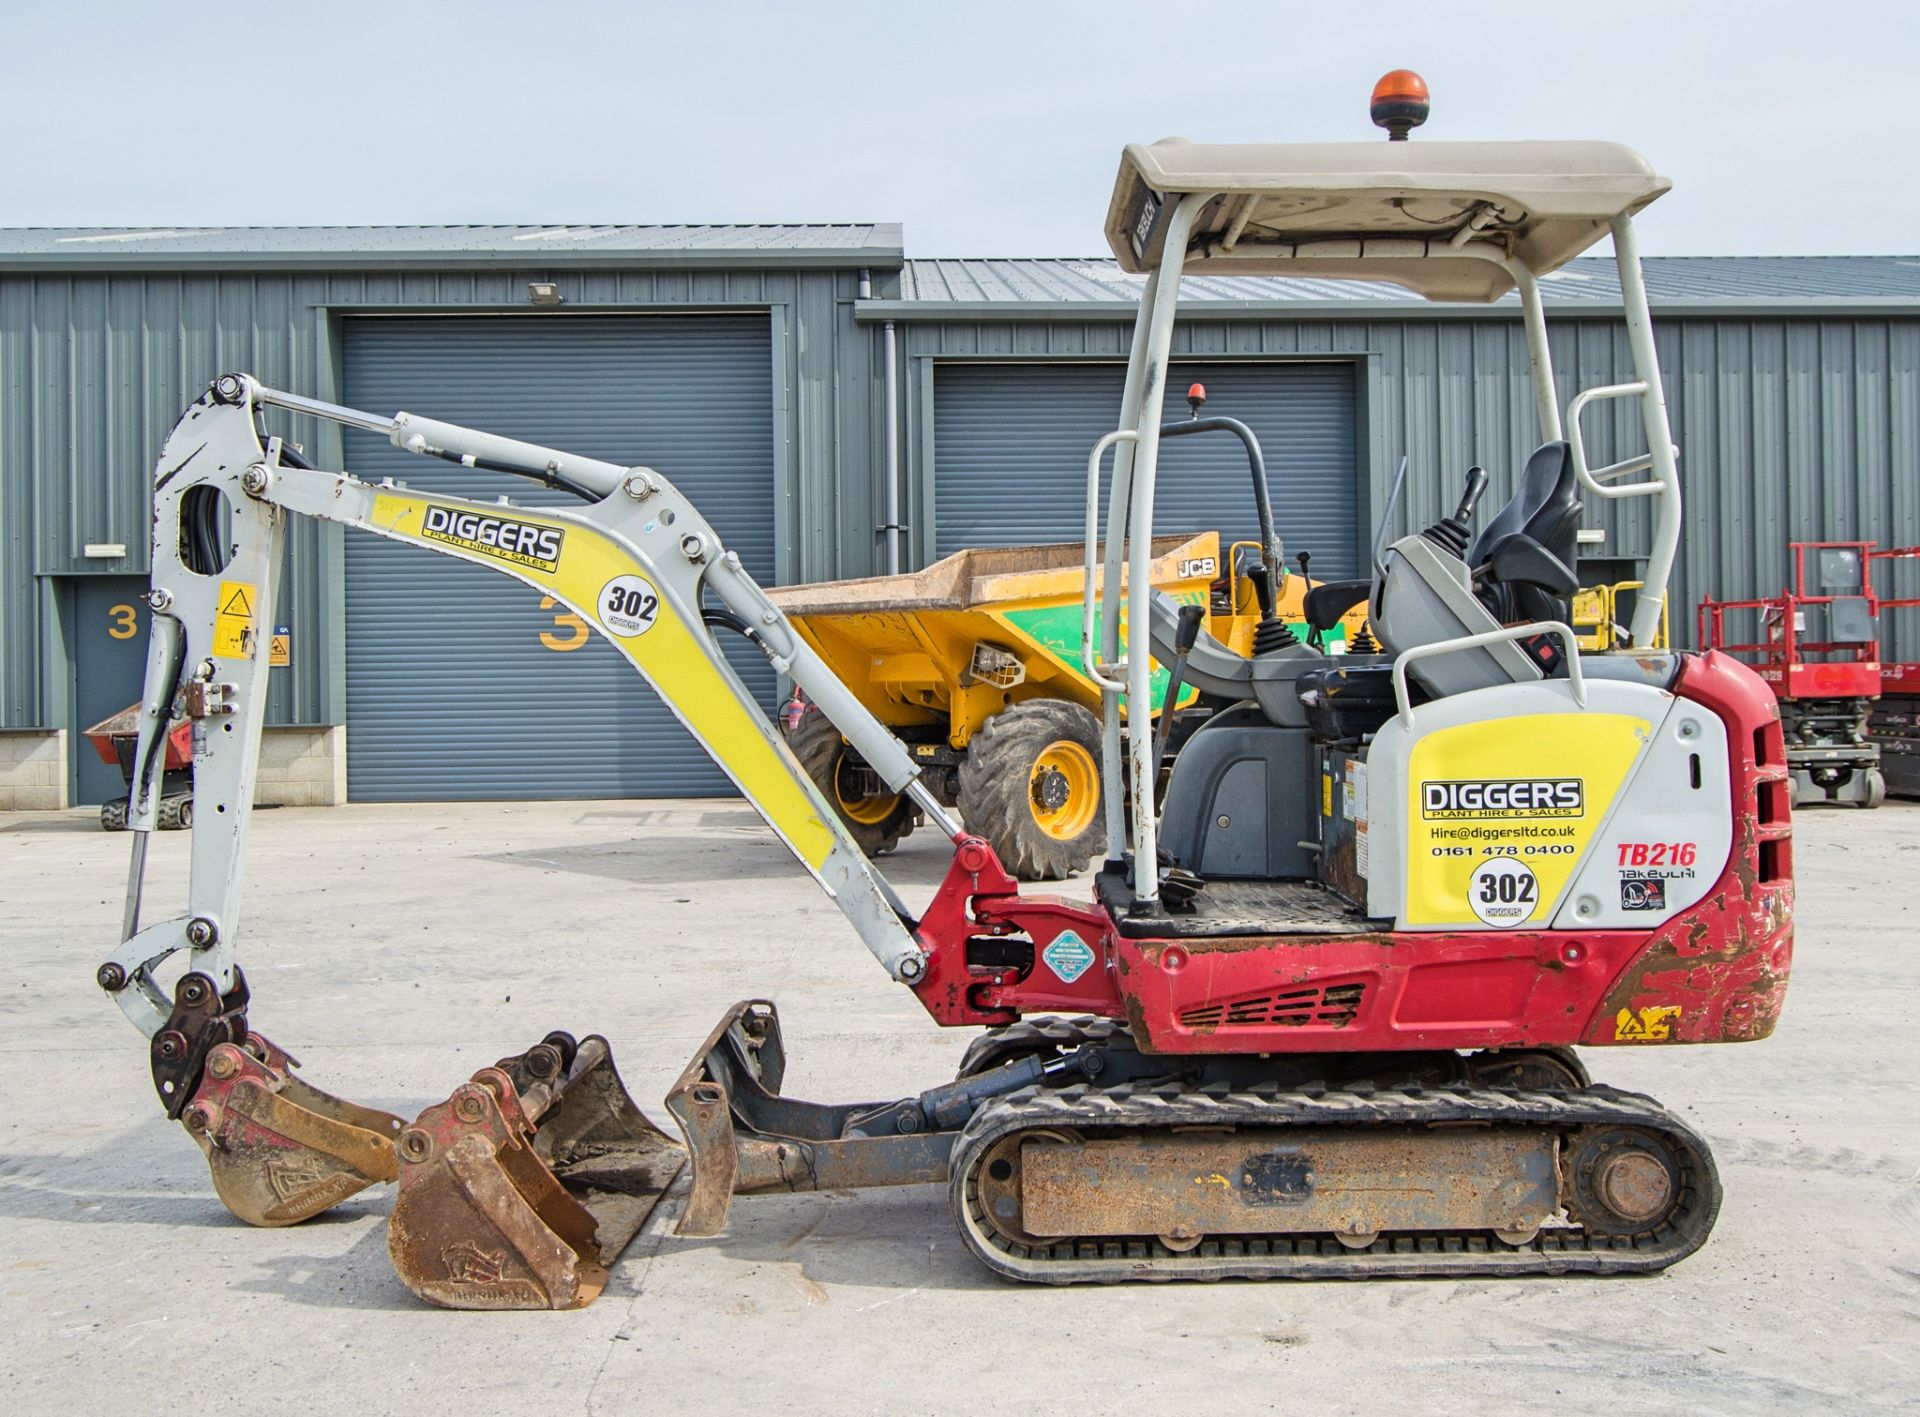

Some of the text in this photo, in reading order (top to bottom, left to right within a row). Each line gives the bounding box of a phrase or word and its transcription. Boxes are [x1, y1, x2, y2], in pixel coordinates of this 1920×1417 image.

[426, 508, 561, 561] DIGGERS
[430, 531, 547, 569] PLANT HIRE & SALES
[1178, 557, 1215, 577] JCB
[608, 586, 657, 621] 302
[108, 604, 138, 640] 3
[539, 595, 589, 651] 3
[1426, 782, 1579, 809] DIGGERS
[1432, 810, 1475, 818] PLANT
[1479, 809, 1509, 817] HIRE
[1431, 826, 1575, 840] Hire@diggersltd.co.uk
[1432, 845, 1575, 856] 0161 478 0400
[1617, 843, 1697, 866] TB216
[1480, 874, 1534, 903] 302
[1486, 908, 1521, 917] DIGGERS
